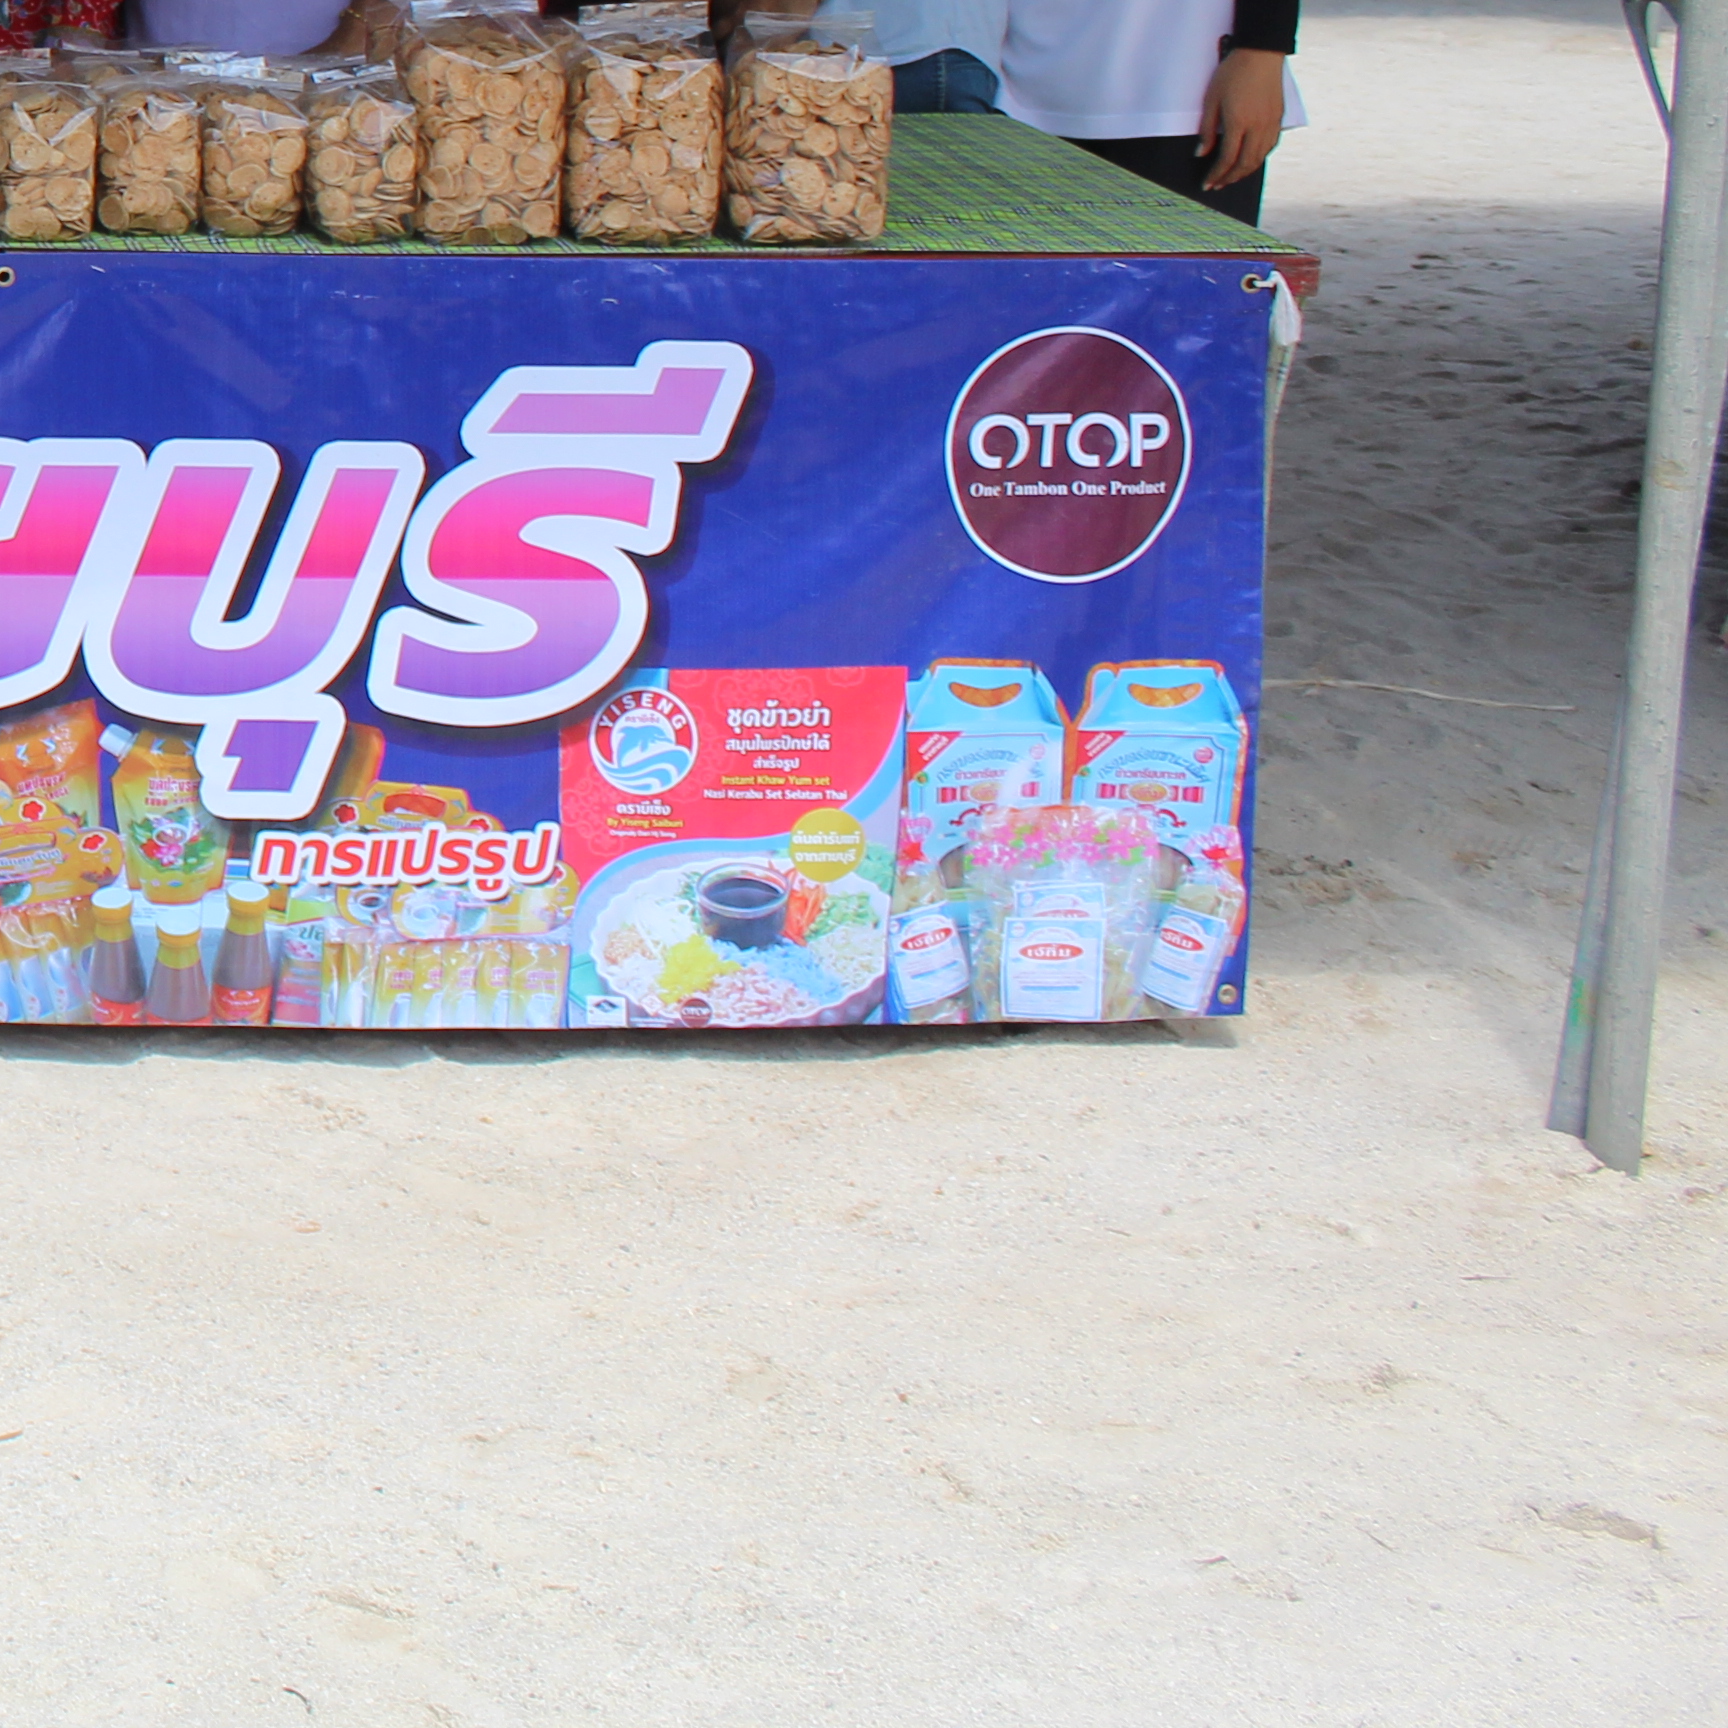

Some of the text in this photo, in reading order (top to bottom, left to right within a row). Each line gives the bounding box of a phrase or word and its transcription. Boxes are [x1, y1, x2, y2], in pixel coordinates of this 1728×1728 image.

[968, 412, 1170, 469] OTOP
[969, 479, 1166, 498] One Tambon One Product
[598, 692, 687, 731] YISENG
[726, 698, 832, 734] ชุดข้าวยำ
[752, 754, 800, 772] สำเร็จรูป
[721, 775, 755, 786] Instant
[788, 775, 813, 786] Yum
[814, 775, 831, 786] set
[703, 788, 726, 799] Nasi
[765, 788, 783, 800] Set
[825, 789, 848, 801] Thai
[257, 827, 555, 894] การแปรรูป
